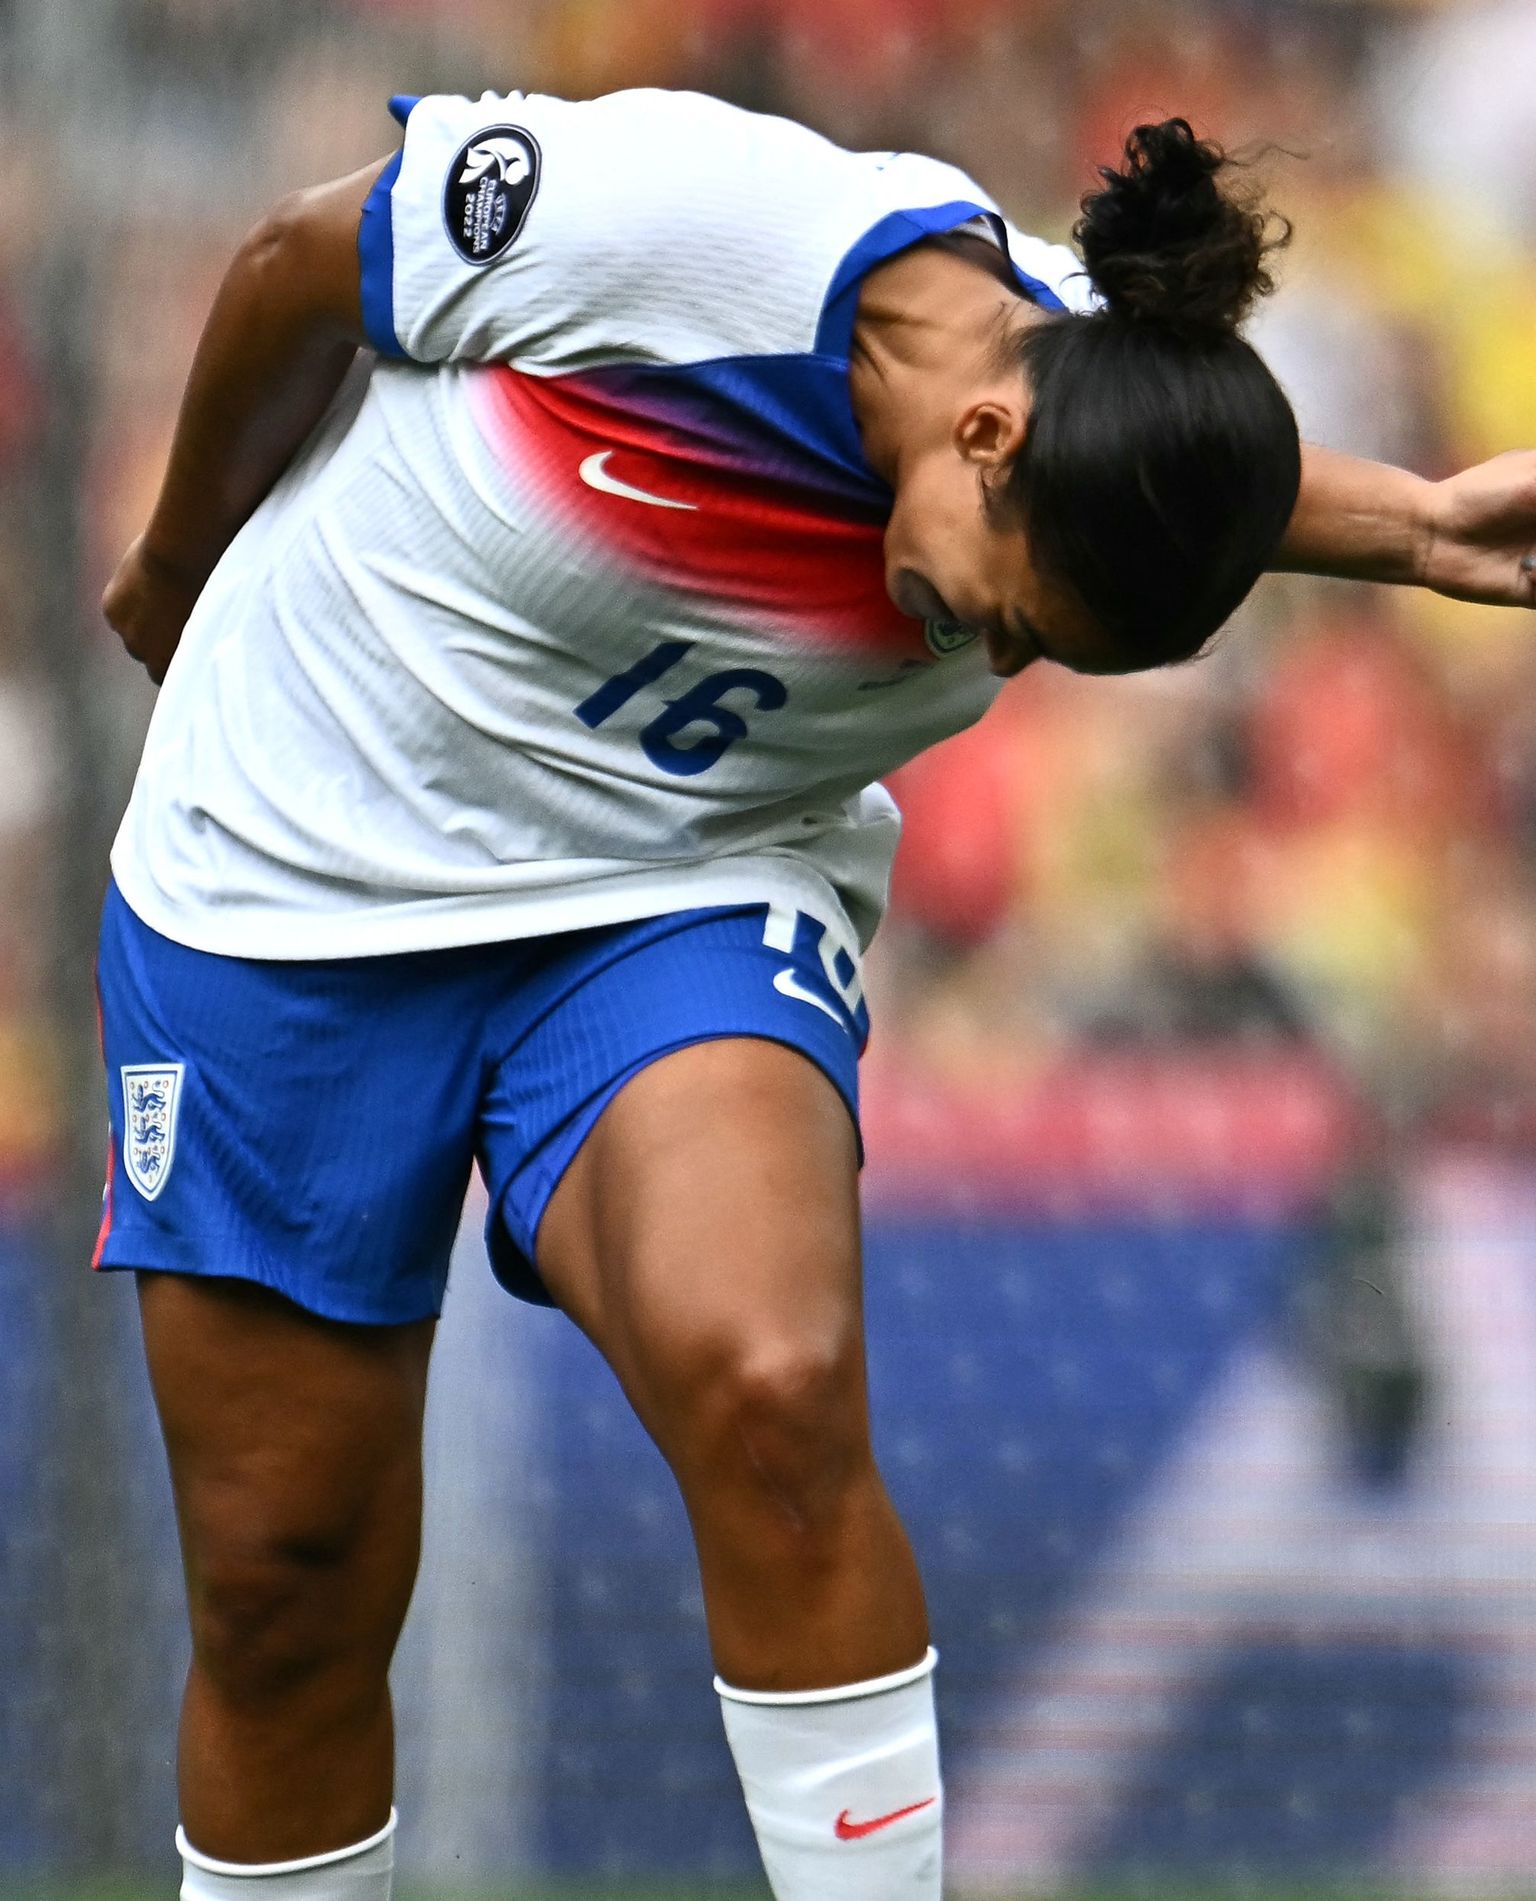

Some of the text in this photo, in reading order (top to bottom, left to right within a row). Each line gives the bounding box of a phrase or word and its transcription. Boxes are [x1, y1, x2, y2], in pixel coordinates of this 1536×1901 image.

[463, 193, 477, 238] 2022
[472, 175, 489, 253] CHAMPIONS
[479, 178, 498, 250] EUROPEAN
[572, 641, 788, 777] 16
